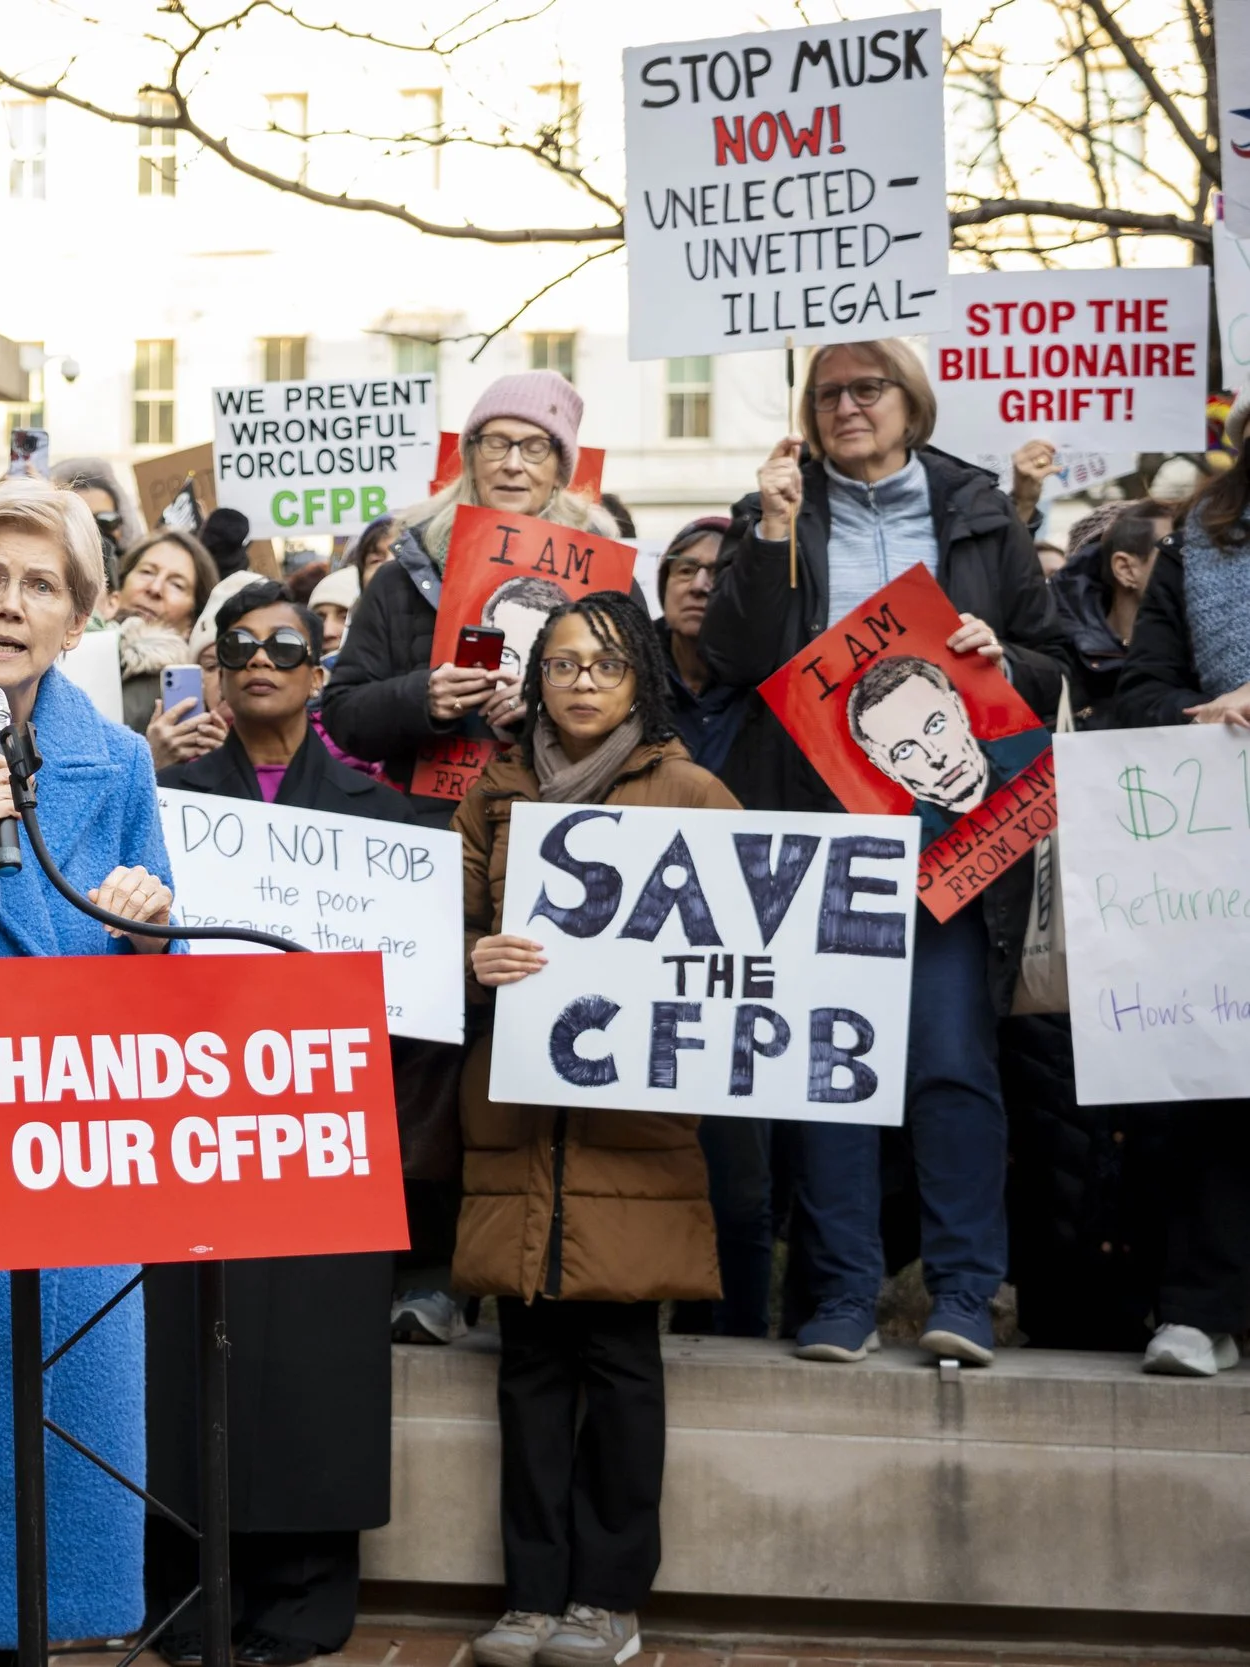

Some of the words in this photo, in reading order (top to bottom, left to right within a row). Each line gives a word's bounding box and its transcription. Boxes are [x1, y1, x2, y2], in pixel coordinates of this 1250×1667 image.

[641, 47, 771, 108] STOP
[789, 28, 929, 93] MUSK
[713, 104, 846, 166] NOW!
[966, 301, 1075, 336] STOP
[1087, 299, 1168, 333] THE
[938, 343, 1197, 381] BILLIONAIRE
[215, 389, 265, 416] WE
[285, 379, 432, 412] PREVENT
[999, 388, 1135, 423] GRIFT!
[230, 414, 416, 446] WRONGFUL
[271, 486, 388, 527] CFPB
[489, 524, 520, 565] I
[531, 537, 594, 585] AM
[801, 656, 840, 701] I
[844, 603, 907, 672] AM
[268, 823, 343, 871] NOT
[366, 836, 434, 882] ROB
[945, 836, 1018, 902] FROM
[254, 876, 299, 906] the
[317, 890, 375, 917] poor
[526, 809, 906, 958] SAVE
[311, 922, 365, 952] they
[378, 935, 417, 958] are
[662, 953, 775, 999] THE
[244, 1027, 370, 1096] OFF
[548, 993, 878, 1103] CFPB
[11, 1119, 159, 1191] OUR
[170, 1110, 370, 1184] CFPB!
